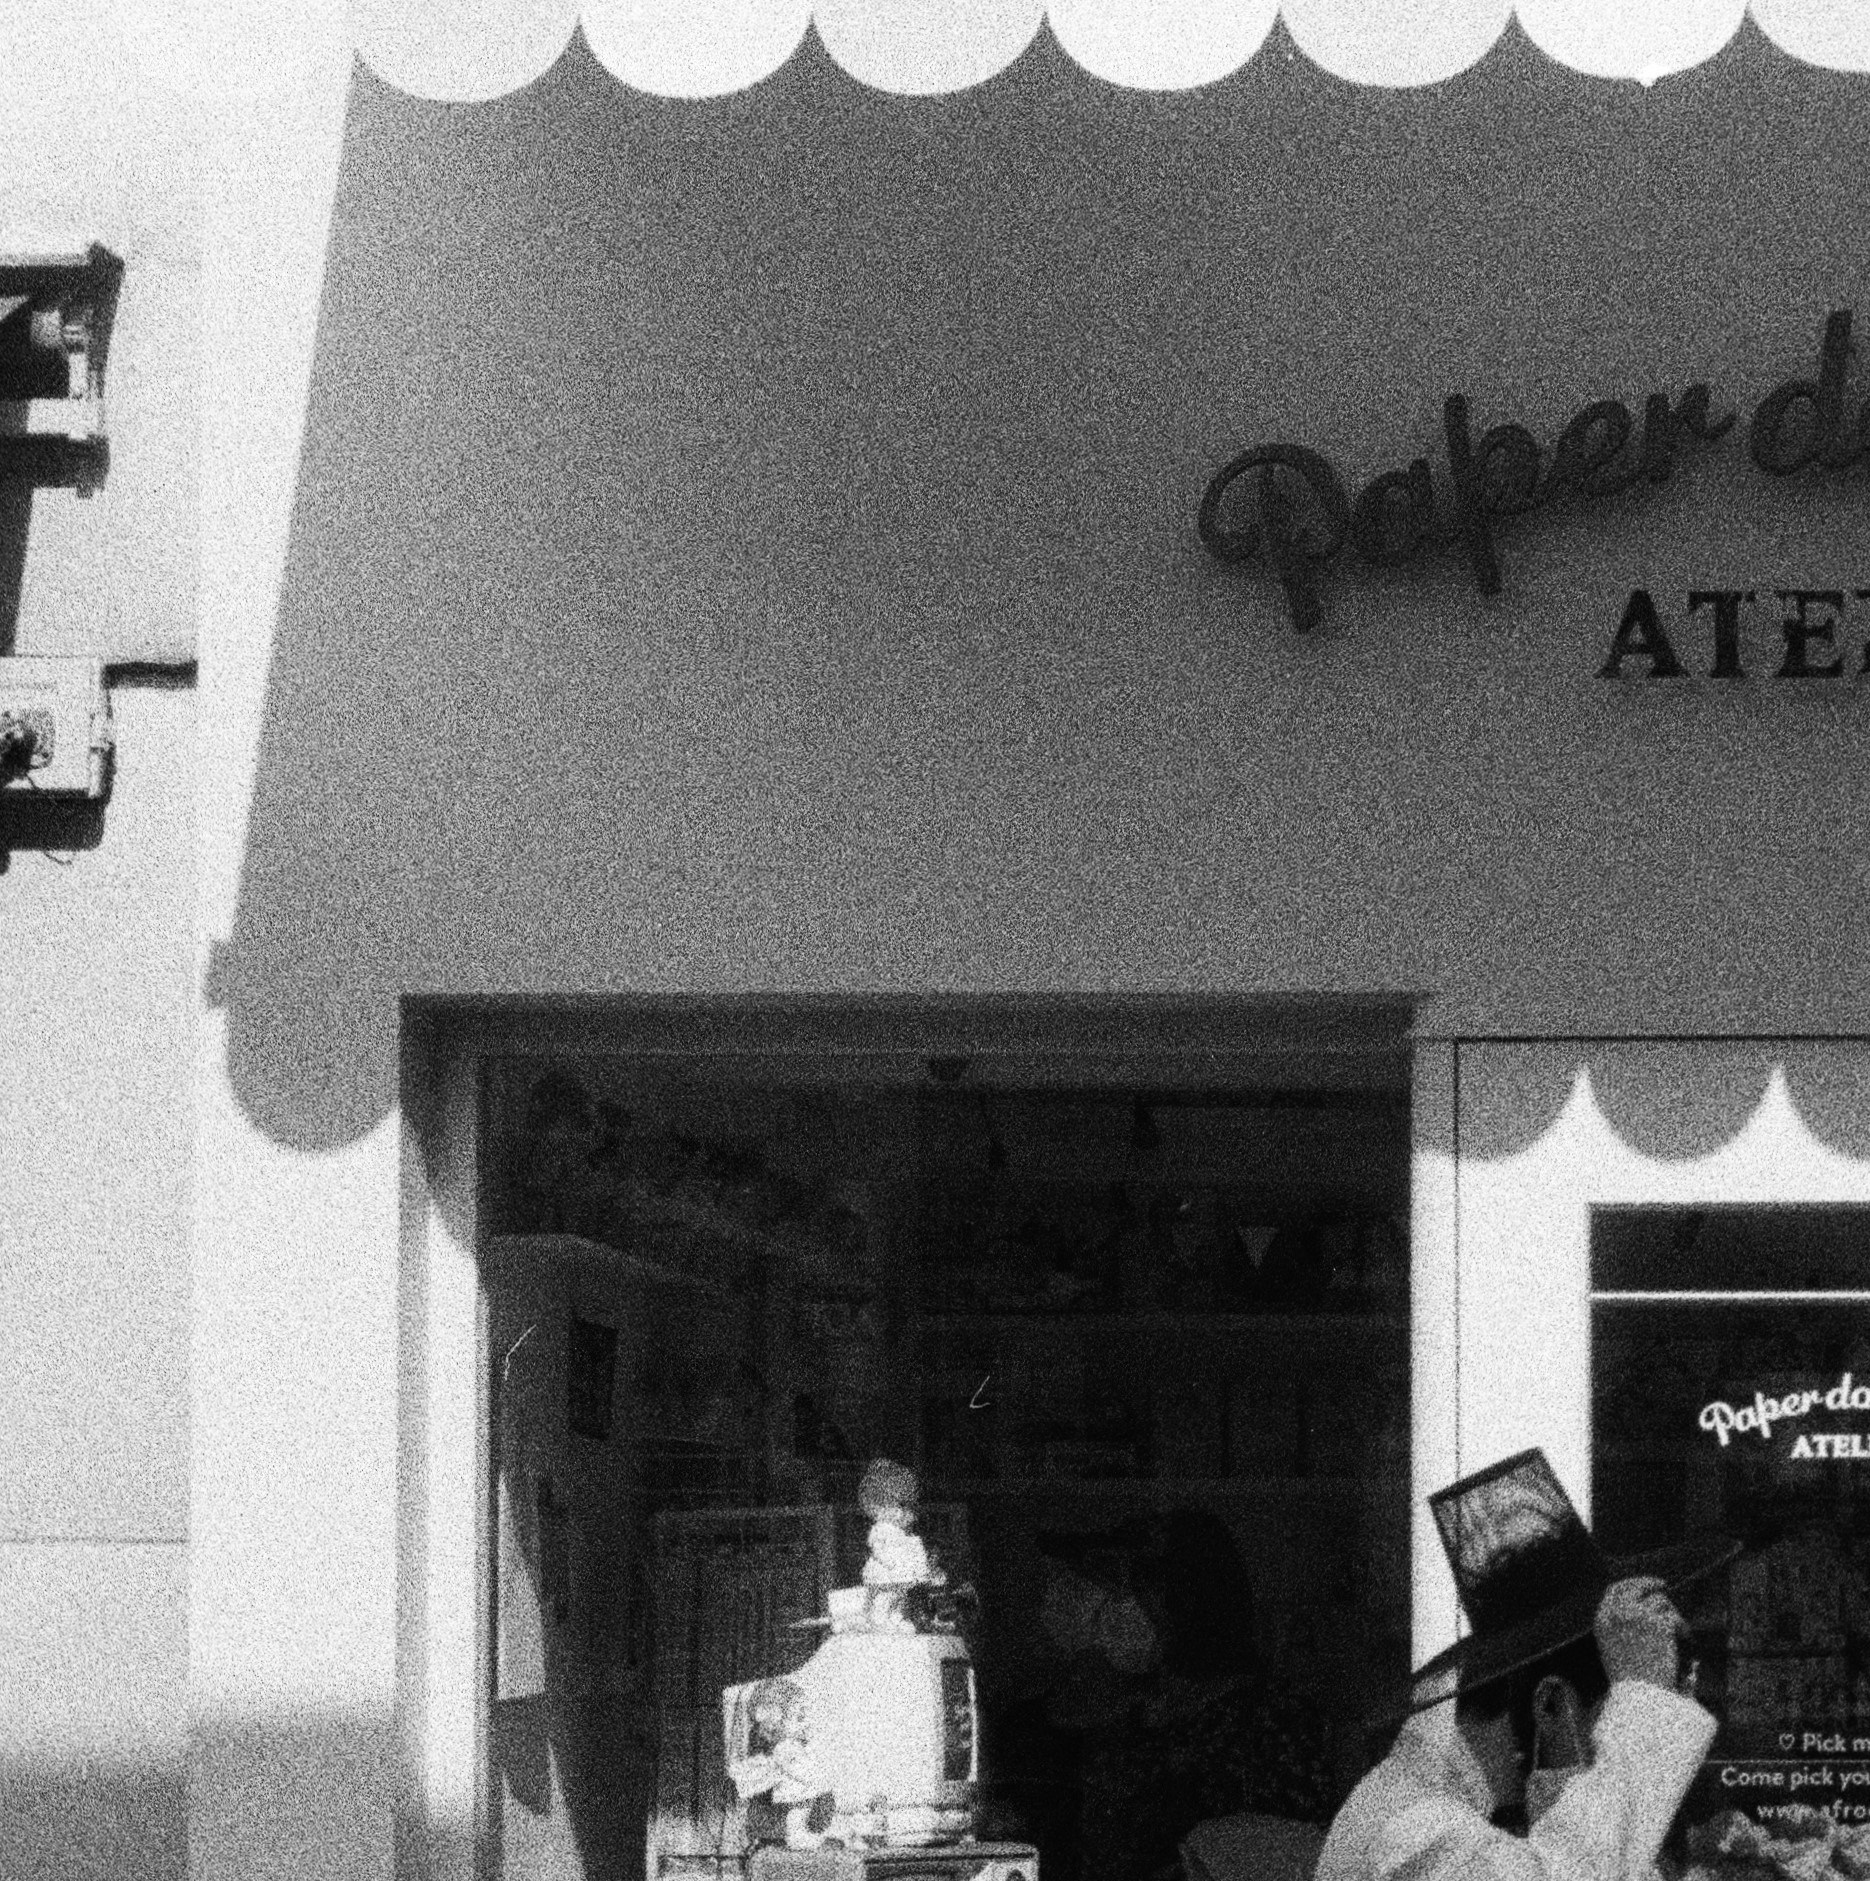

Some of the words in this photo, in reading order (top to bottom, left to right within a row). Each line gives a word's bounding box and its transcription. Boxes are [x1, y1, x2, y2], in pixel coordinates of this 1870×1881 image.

[1803, 1733, 1846, 1752] Pick
[1721, 1766, 1784, 1787] Come
[1790, 1766, 1833, 1791] pick
